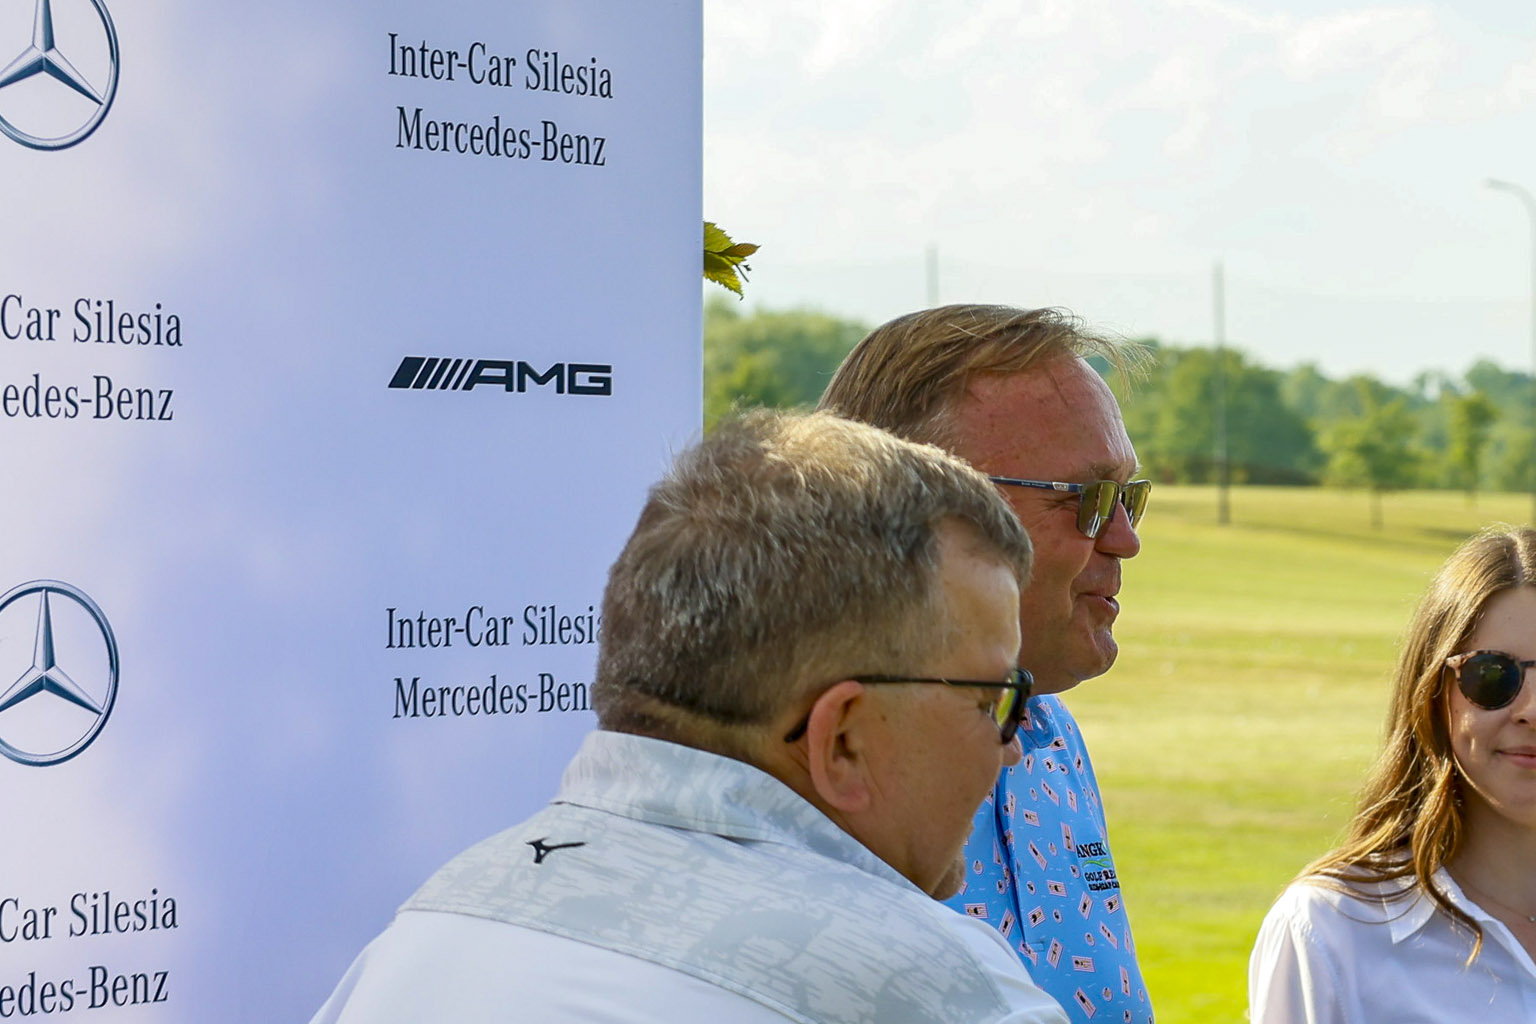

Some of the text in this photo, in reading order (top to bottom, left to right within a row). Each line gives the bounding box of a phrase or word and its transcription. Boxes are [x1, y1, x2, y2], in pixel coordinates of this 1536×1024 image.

[388, 32, 613, 99] Inter-Car Silesia
[396, 106, 606, 166] Mercedes-Benz
[0, 294, 183, 346] Car Silesia
[2, 373, 174, 420] edes-Benz
[461, 359, 612, 396] AMG
[385, 605, 514, 649] Inter-Car
[392, 672, 593, 719] Mercedes-Ben
[1076, 841, 1107, 858] ANGK
[0, 887, 179, 943] Car Silesia
